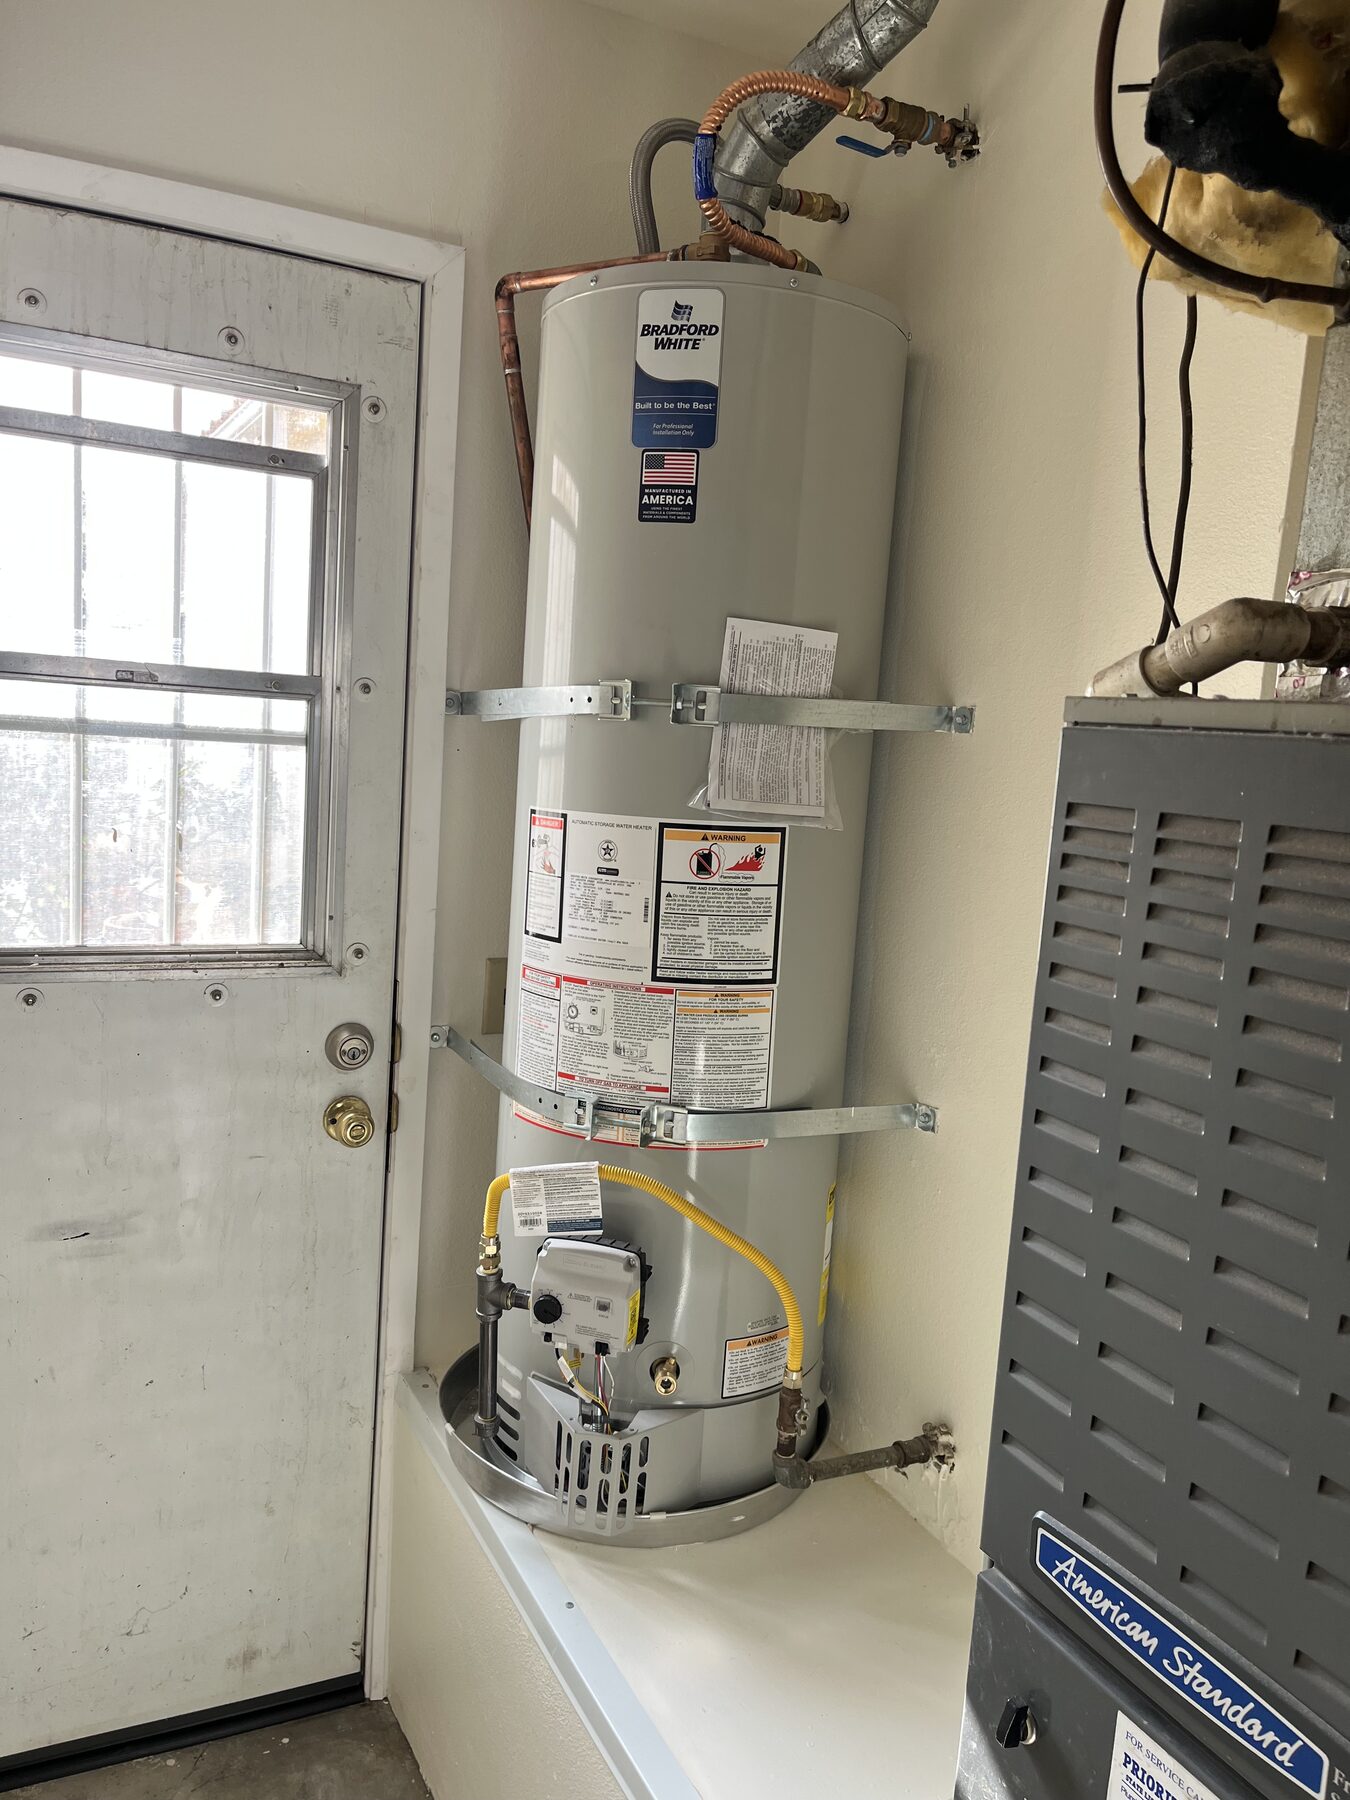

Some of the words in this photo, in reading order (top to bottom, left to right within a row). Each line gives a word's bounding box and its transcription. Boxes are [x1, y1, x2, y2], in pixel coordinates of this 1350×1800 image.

[640, 324, 719, 337] BRADFORD
[654, 338, 701, 350] WHITE
[636, 402, 652, 410] Built
[693, 402, 712, 410] Best
[642, 494, 693, 505] AMERICA
[711, 834, 746, 842] WARNING
[752, 1334, 778, 1345] WARNING
[1051, 1556, 1159, 1656] American
[1162, 1646, 1304, 1768] Standard
[1125, 1731, 1143, 1752] FOR
[1145, 1749, 1185, 1789] SERVICE
